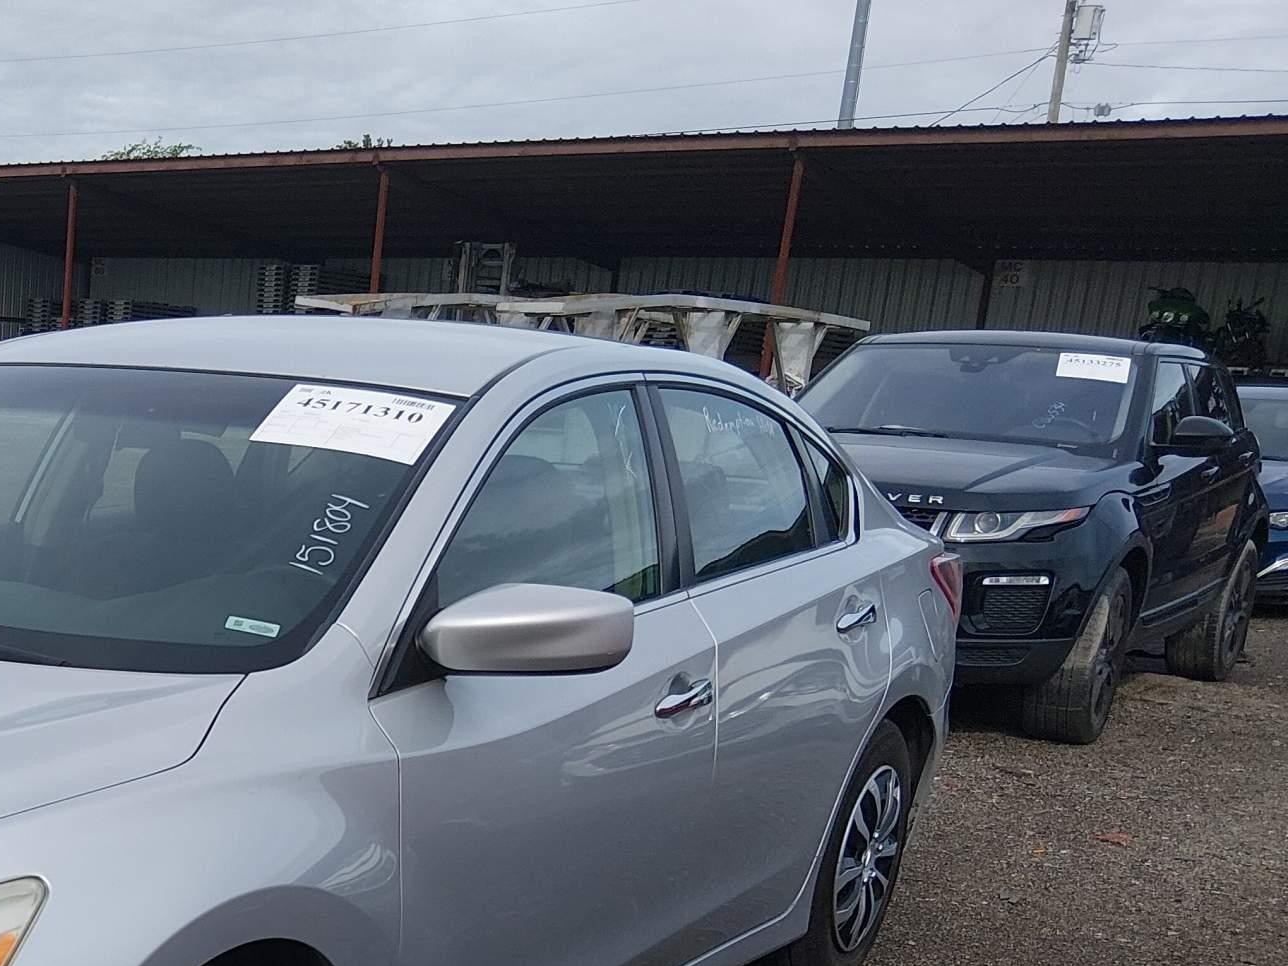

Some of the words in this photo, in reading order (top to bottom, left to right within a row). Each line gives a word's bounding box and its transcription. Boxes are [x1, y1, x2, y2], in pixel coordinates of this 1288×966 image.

[296, 397, 424, 424] 45171310
[887, 493, 944, 504] VER
[288, 493, 370, 576] 151804
